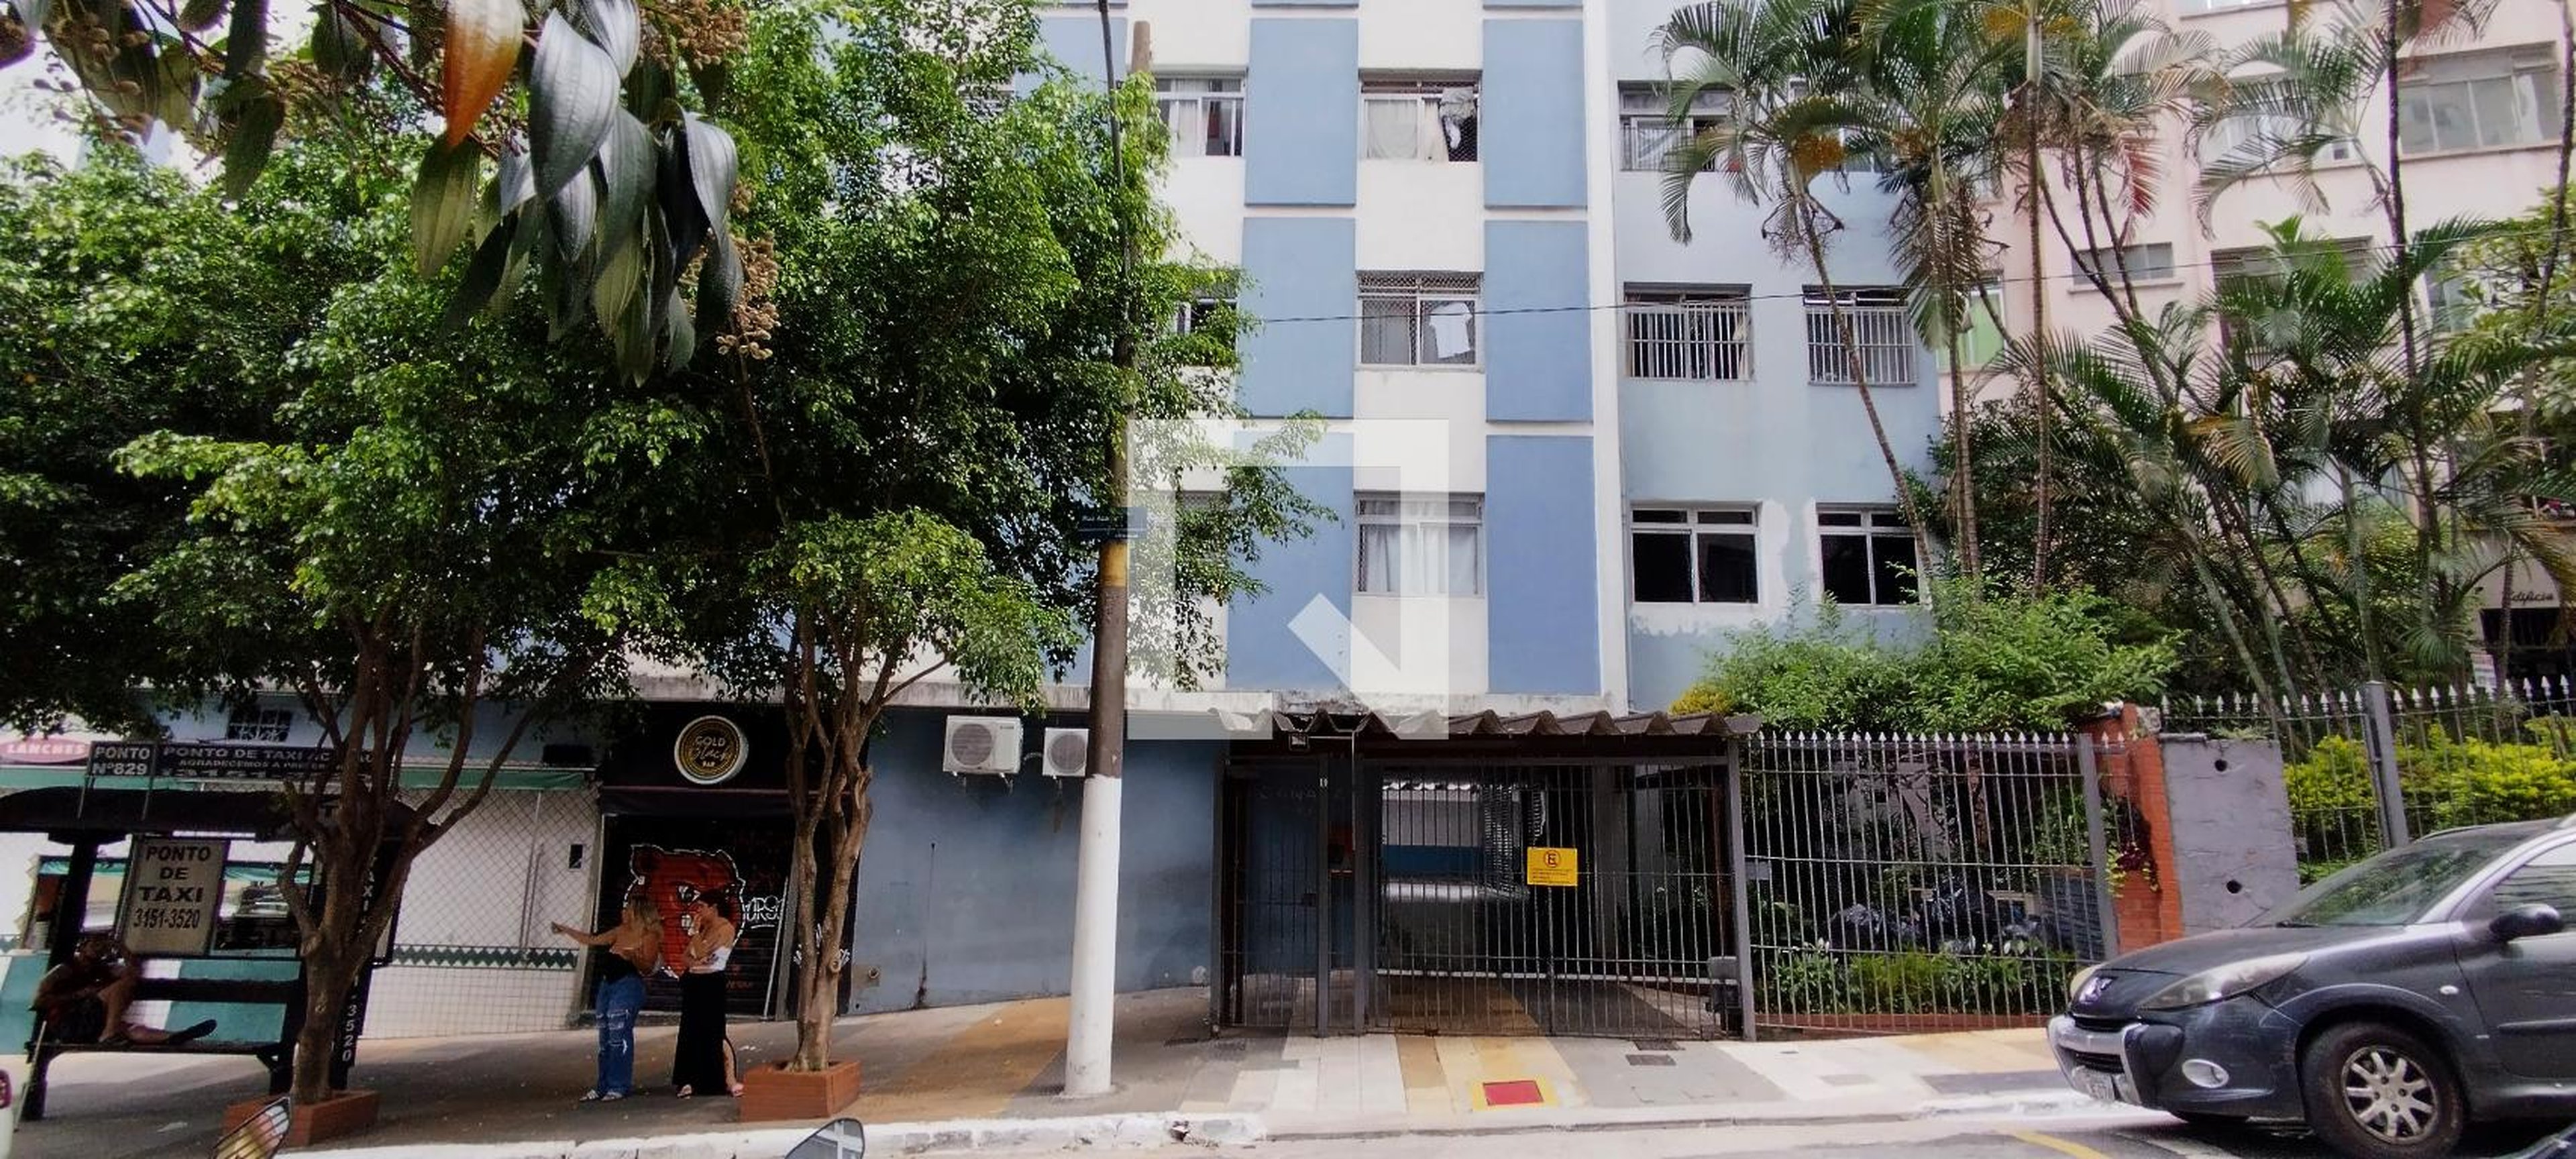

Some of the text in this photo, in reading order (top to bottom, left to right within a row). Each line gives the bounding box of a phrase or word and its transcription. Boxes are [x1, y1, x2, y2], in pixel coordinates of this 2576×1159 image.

[695, 736, 725, 747] GOLD
[7, 744, 86, 755] LANCHES
[95, 747, 150, 759] PONTO
[163, 748, 229, 757] PONTO
[235, 749, 258, 759] DE
[263, 750, 303, 761] TAXI
[146, 846, 211, 861] PONTO
[160, 867, 189, 880] DE
[138, 886, 204, 902] TAXI
[134, 907, 201, 929] 3151-3520
